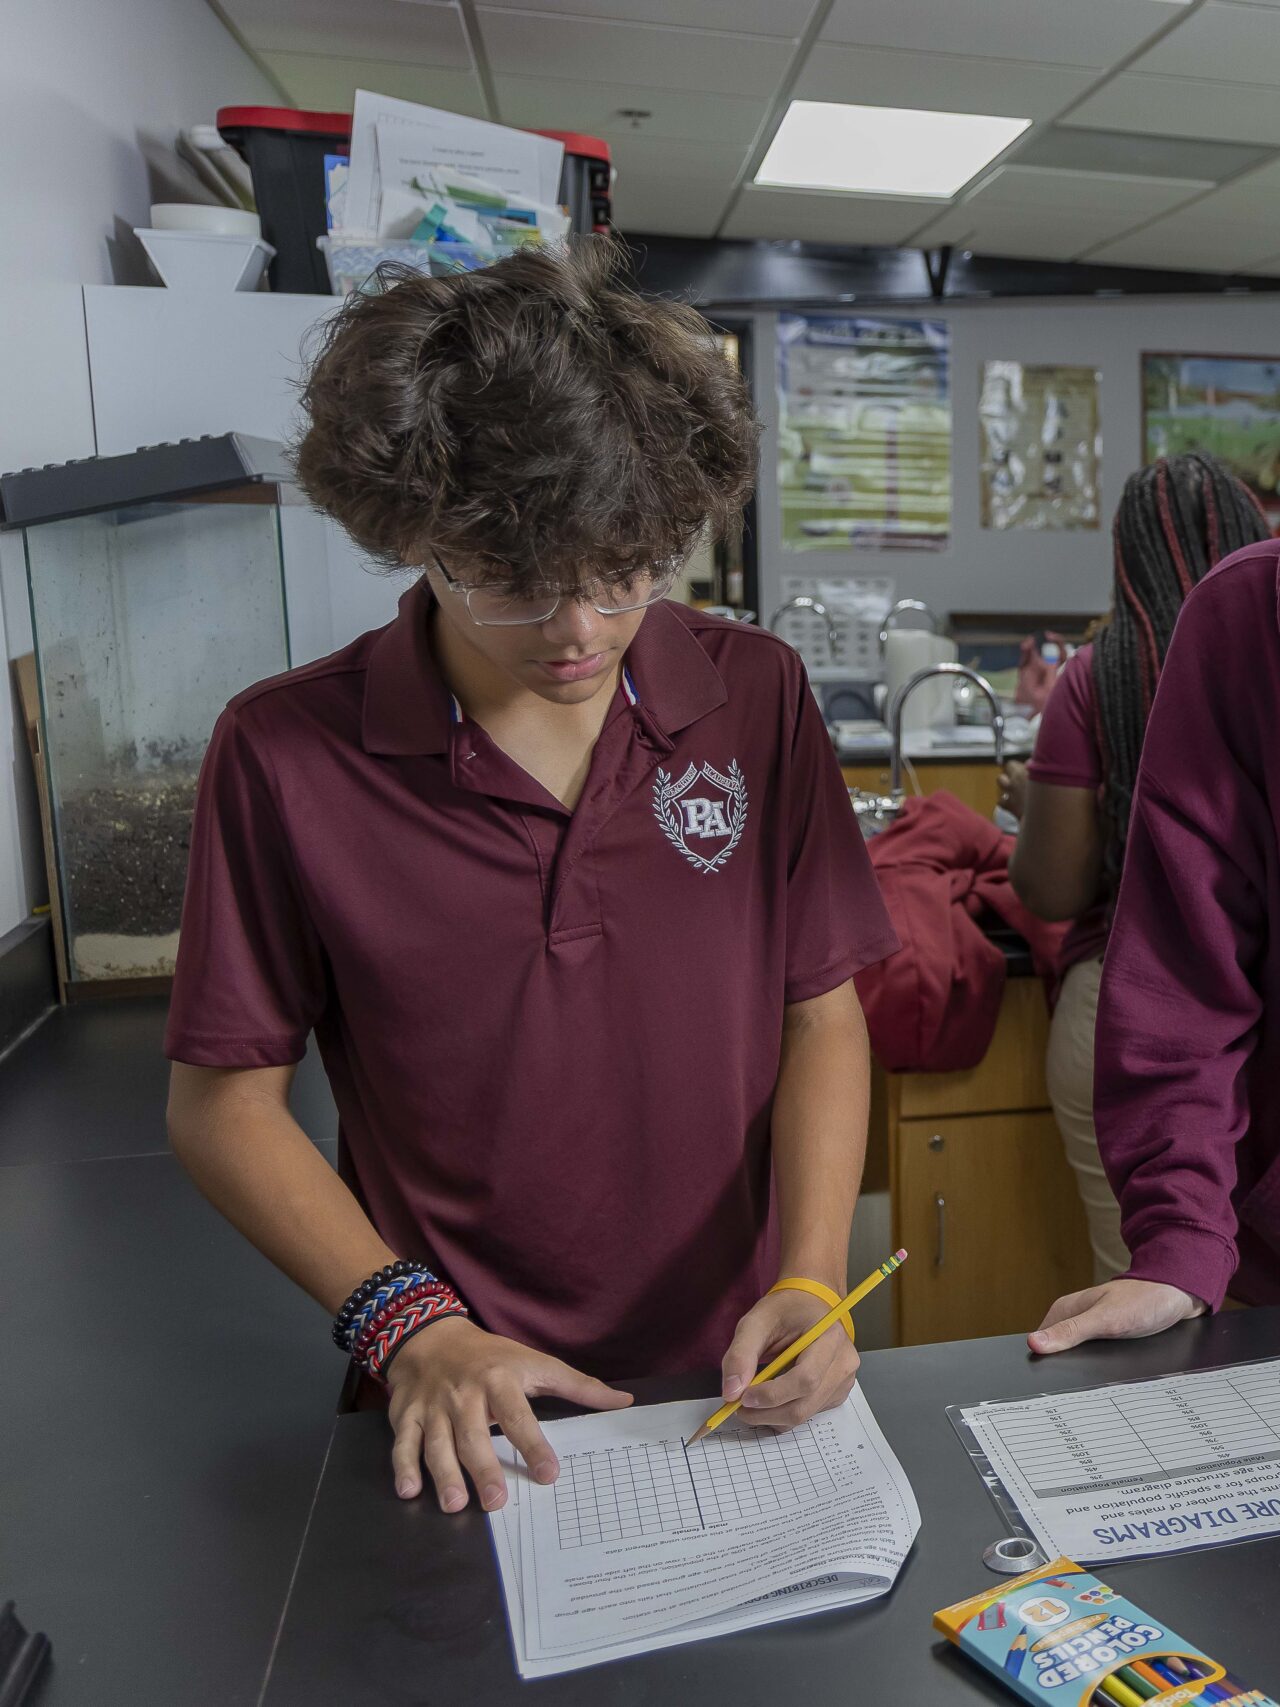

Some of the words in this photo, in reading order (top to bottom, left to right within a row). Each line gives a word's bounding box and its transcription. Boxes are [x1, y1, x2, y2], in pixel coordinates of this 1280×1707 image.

[680, 797, 732, 839] PA
[1194, 1459, 1242, 1470] Population
[1232, 1467, 1254, 1475] age
[1110, 1476, 1143, 1485] Female
[1174, 1471, 1230, 1485] structure
[1060, 1482, 1110, 1492] Population
[1117, 1482, 1172, 1494] diagram.
[1164, 1485, 1211, 1498] specific
[1236, 1488, 1258, 1496] the
[1093, 1493, 1162, 1509] population
[1185, 1492, 1234, 1506] number
[1065, 1506, 1090, 1515] and
[1127, 1505, 1166, 1515] males
[1169, 1502, 1182, 1510] of
[1100, 1511, 1125, 1521] and
[708, 1522, 728, 1530] male
[1093, 1507, 1237, 1544] DIAGRAMS
[671, 1527, 700, 1536] female
[770, 1574, 839, 1598] DESCRIBING
[1023, 1600, 1066, 1622] 12
[1032, 1615, 1134, 1669] PENCILS
[1037, 1623, 1164, 1688] COLORED
